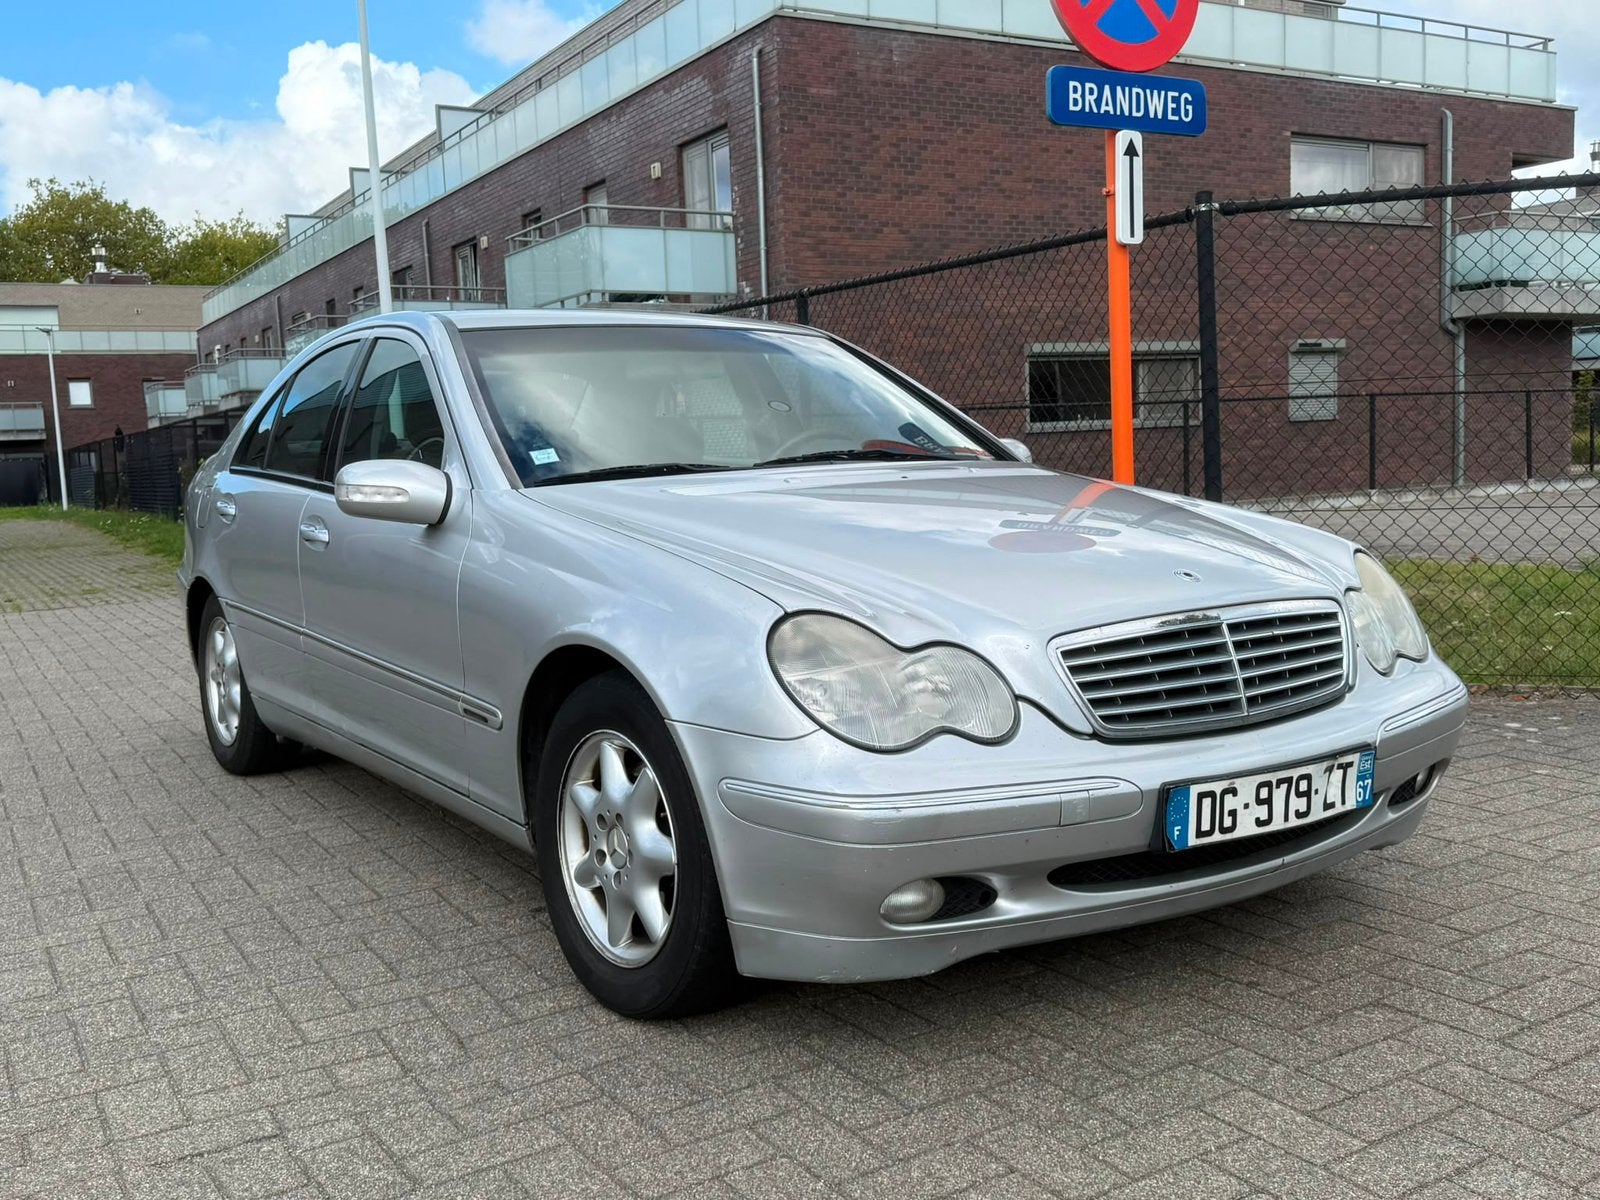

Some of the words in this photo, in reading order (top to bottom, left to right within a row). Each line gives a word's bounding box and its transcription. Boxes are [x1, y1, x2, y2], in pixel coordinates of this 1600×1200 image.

[1068, 80, 1193, 122] BRANDWEG
[1195, 761, 1354, 839] DG-979-ZT
[1356, 778, 1372, 802] 67
[1174, 825, 1182, 840] F
